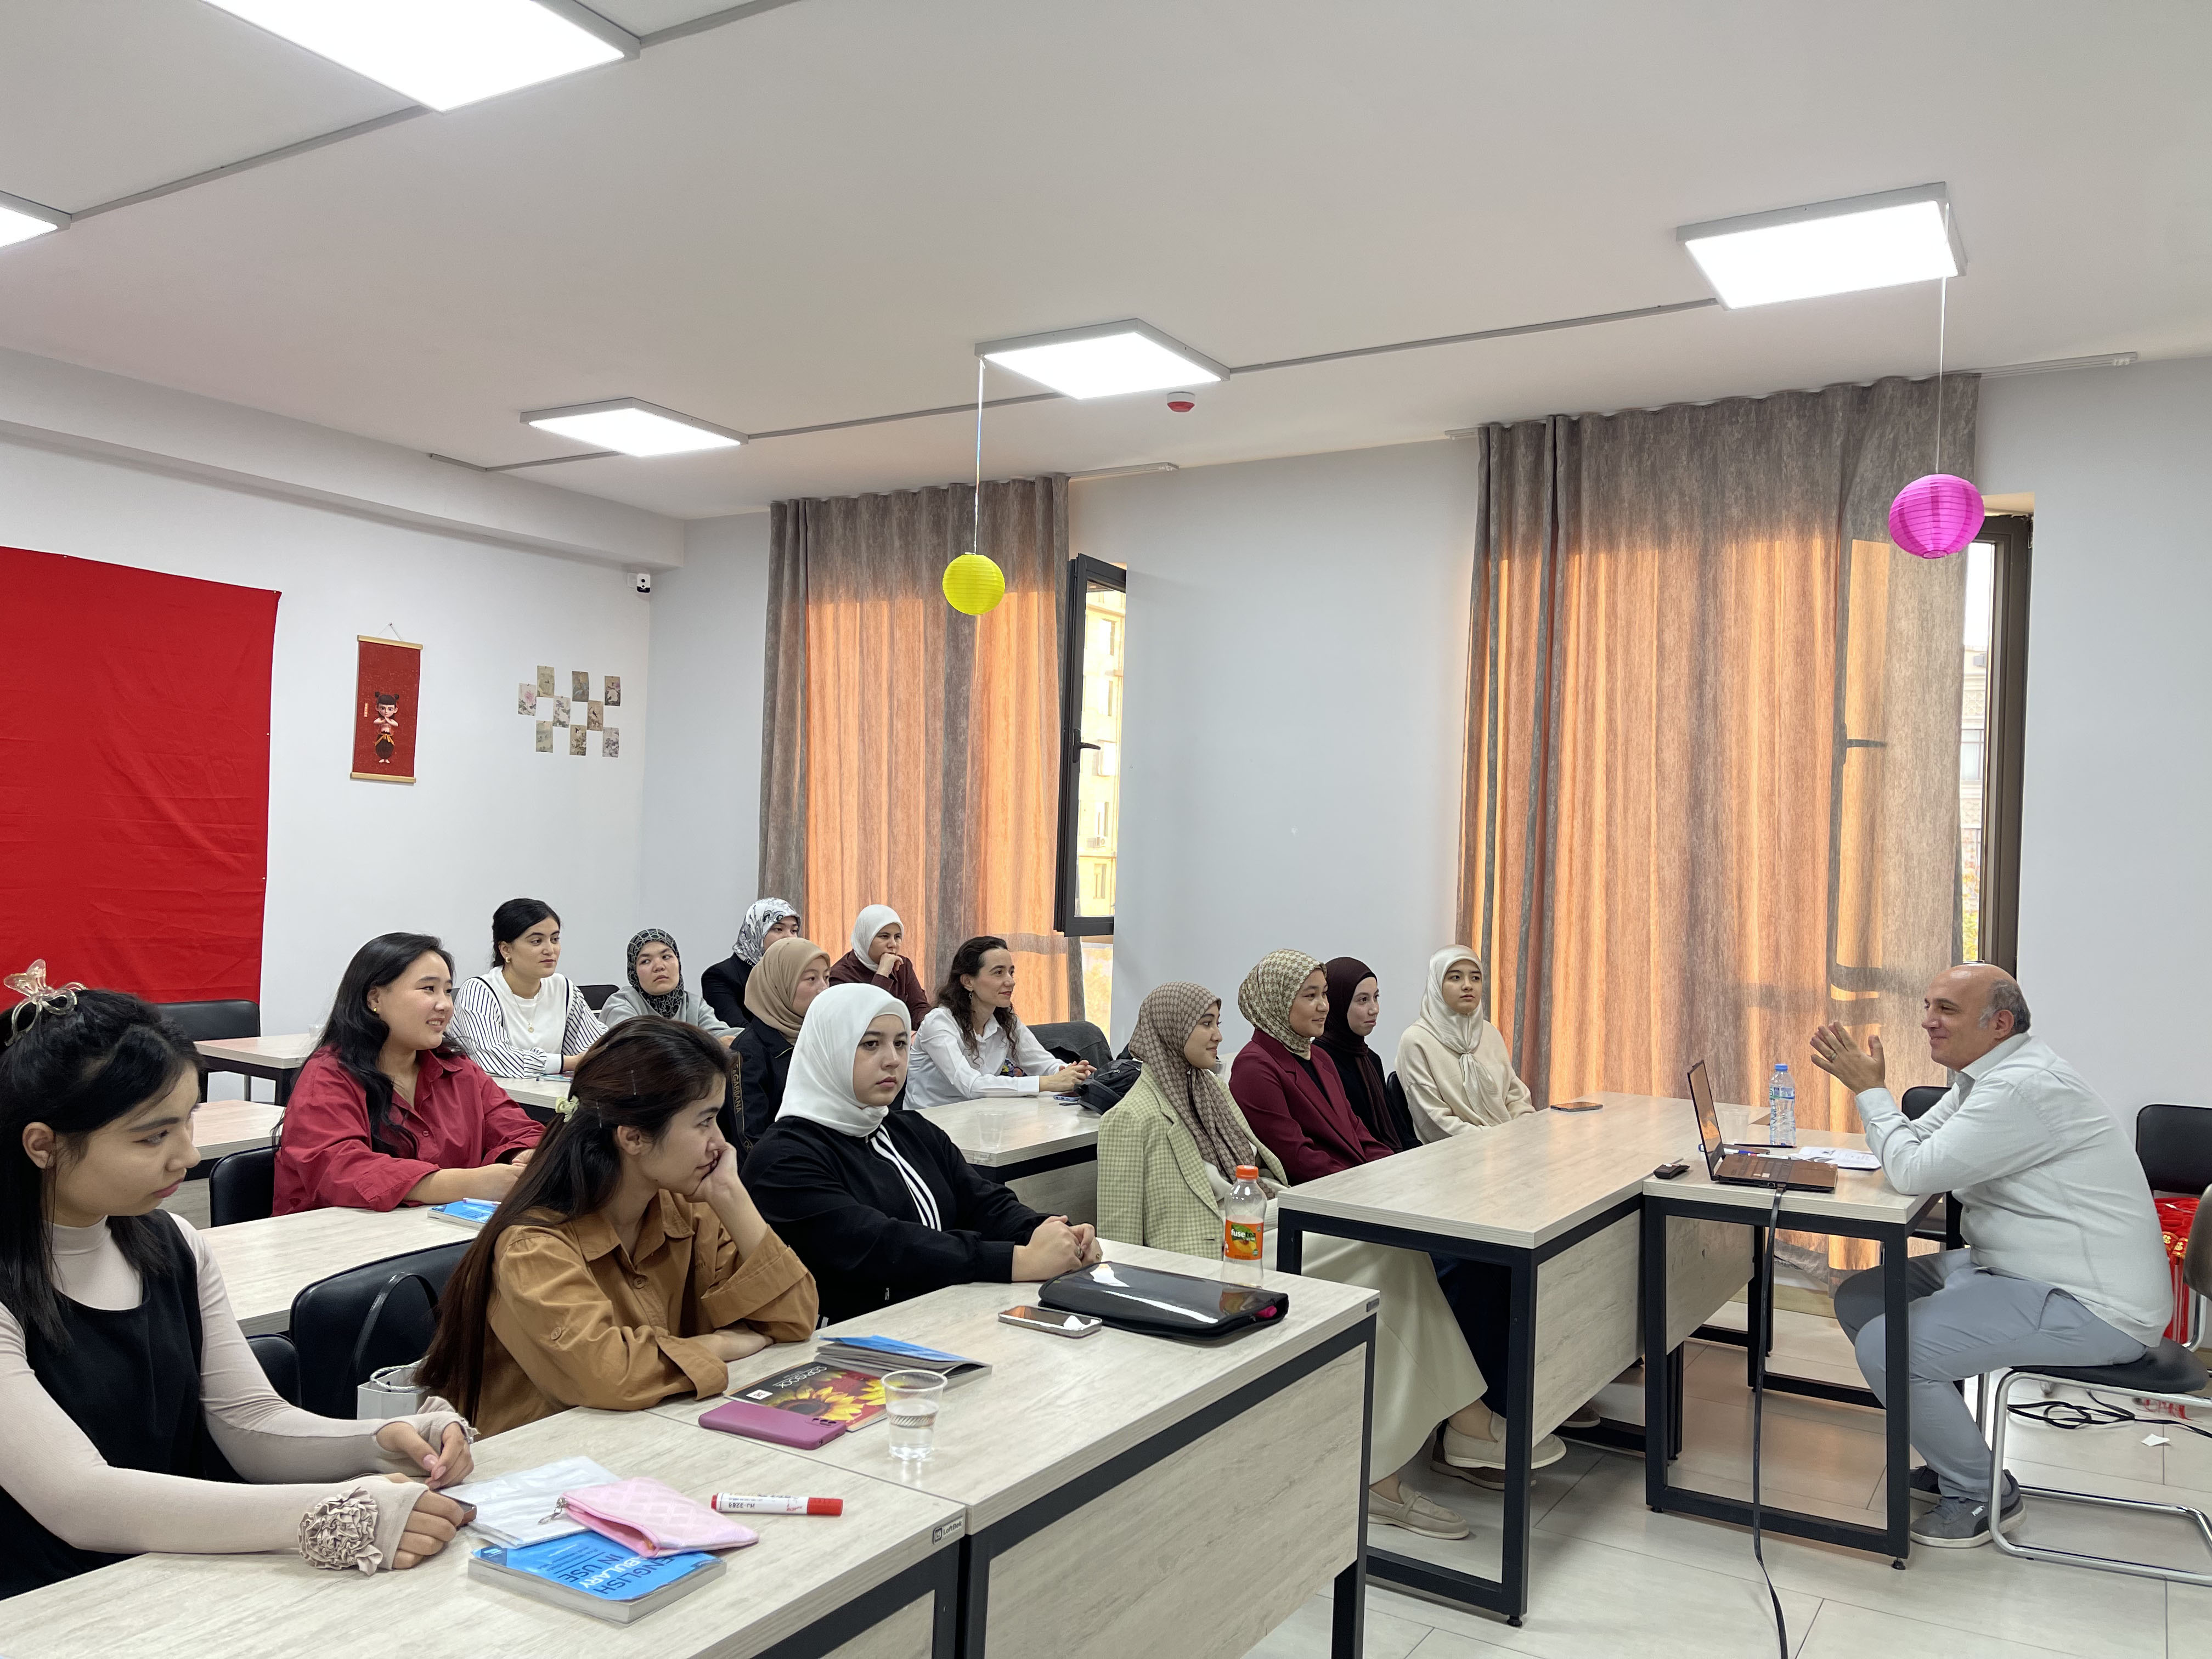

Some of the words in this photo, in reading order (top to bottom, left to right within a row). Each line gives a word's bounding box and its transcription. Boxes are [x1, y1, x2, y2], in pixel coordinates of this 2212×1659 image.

[732, 1074, 742, 1114] GABBANA
[557, 1565, 602, 1583] USE
[579, 1556, 646, 1589] BULARY
[593, 1558, 675, 1594] ENGLISH
[597, 1554, 624, 1565] IN
